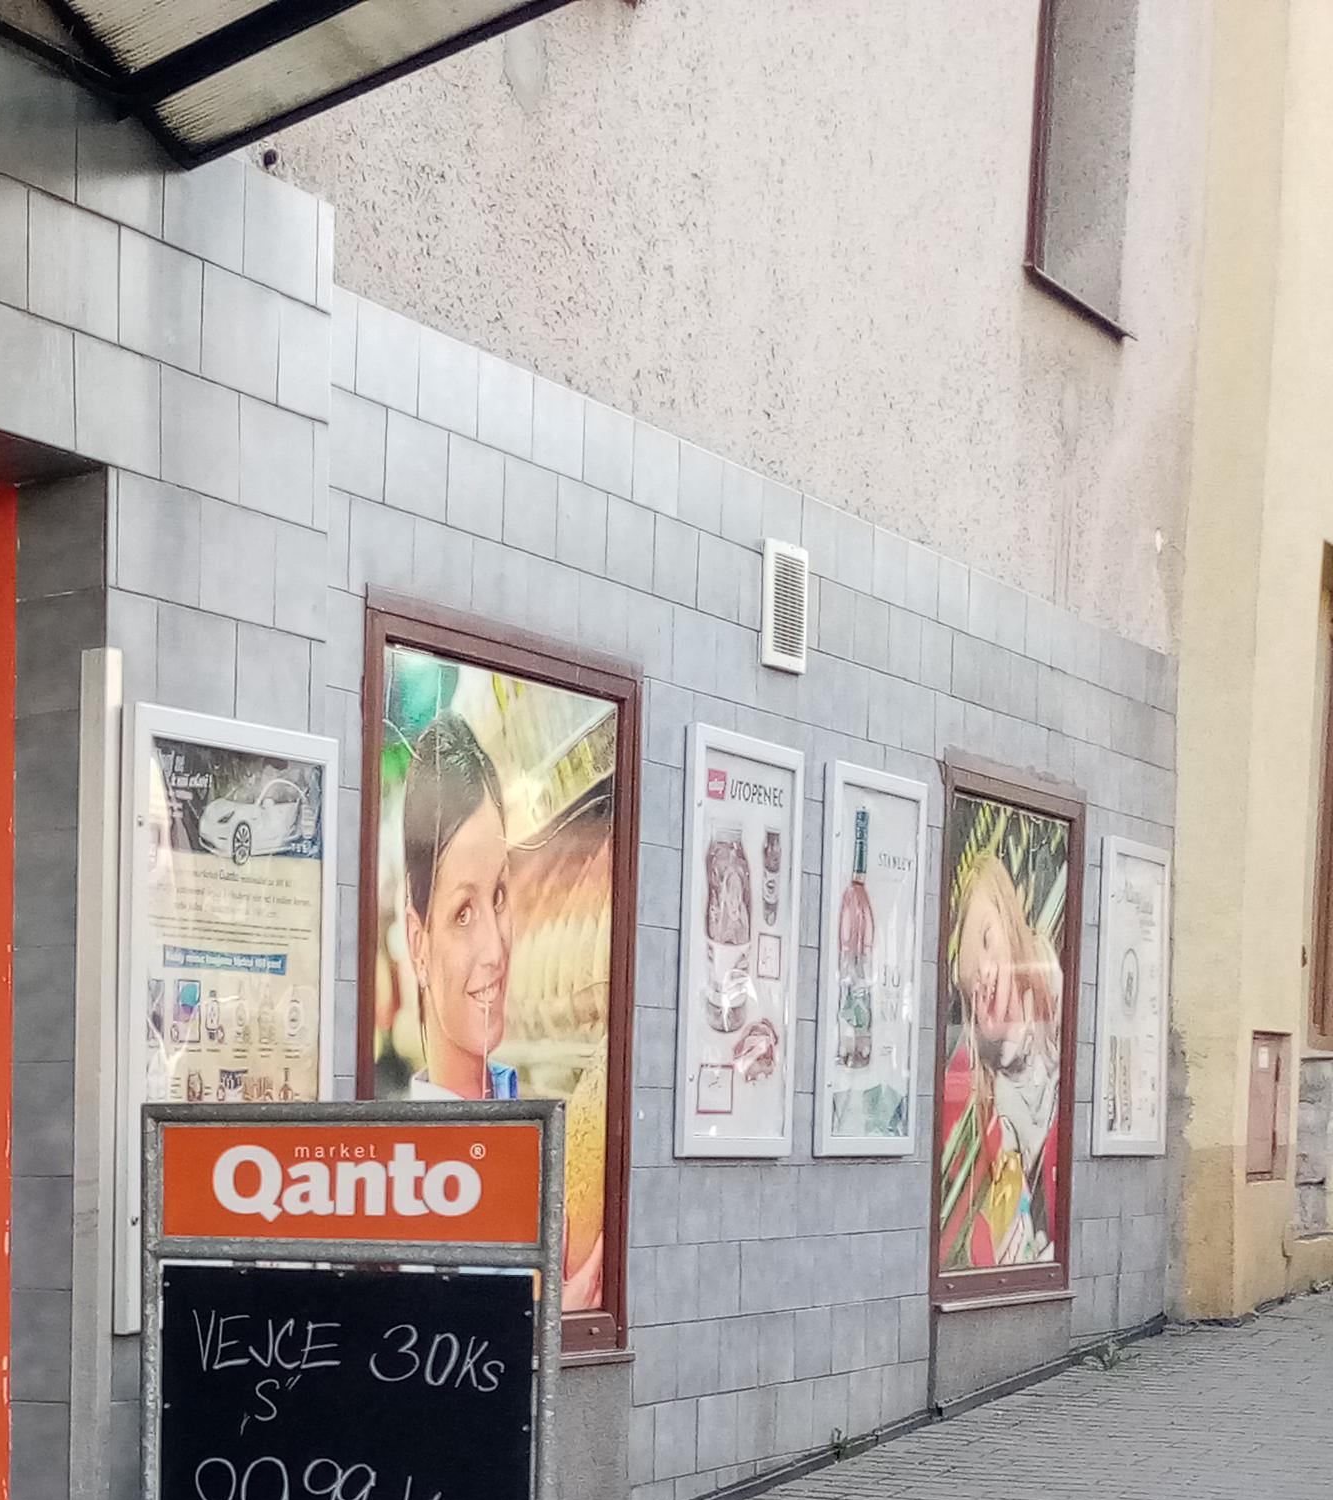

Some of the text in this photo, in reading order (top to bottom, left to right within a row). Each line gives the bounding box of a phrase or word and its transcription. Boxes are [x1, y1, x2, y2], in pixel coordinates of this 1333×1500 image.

[730, 778, 784, 809] UTOPENEC
[293, 1143, 377, 1160] market
[211, 1143, 482, 1222] Qanto
[192, 1309, 341, 1371] VEJCE
